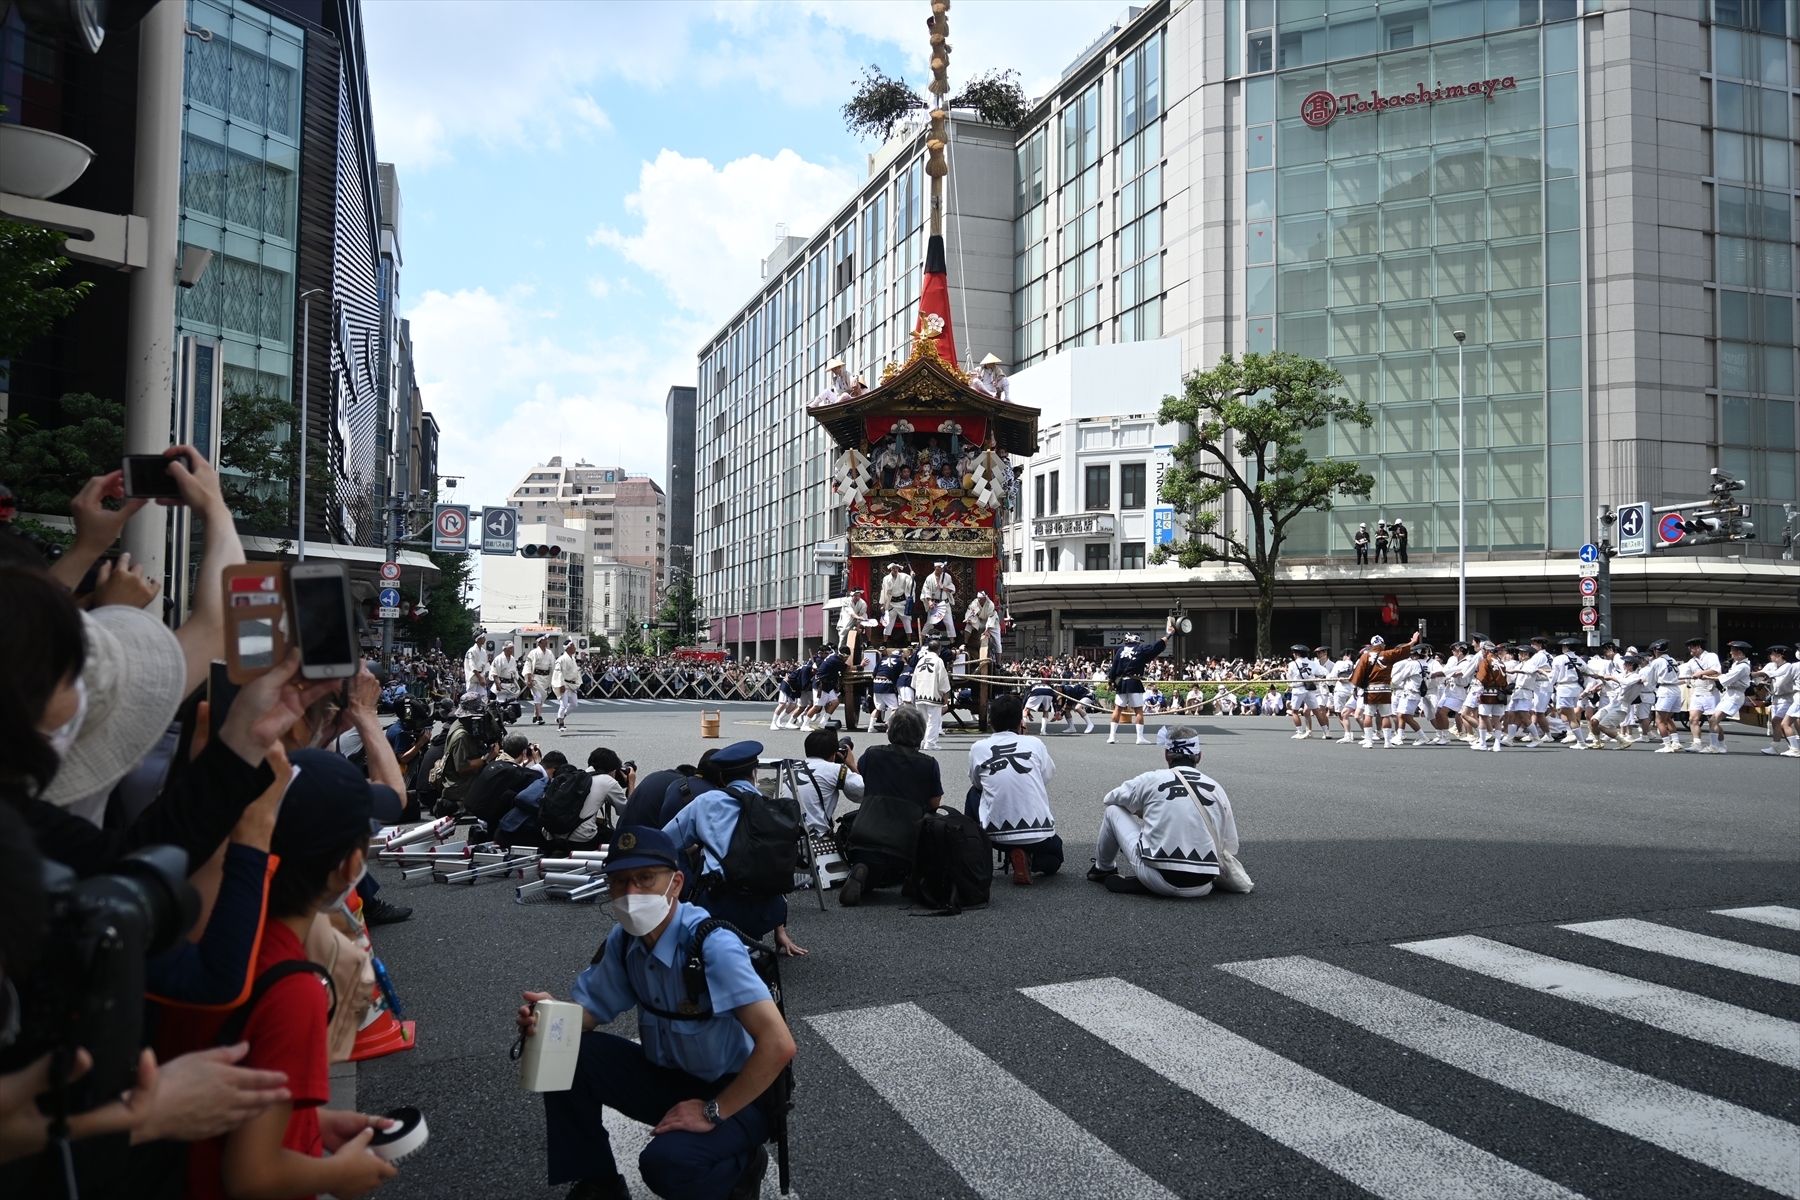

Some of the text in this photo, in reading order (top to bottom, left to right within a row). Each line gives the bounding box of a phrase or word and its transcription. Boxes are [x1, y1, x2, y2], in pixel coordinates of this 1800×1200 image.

[1339, 76, 1516, 115] Takashimaya
[1164, 512, 1171, 529] すぐ
[981, 742, 1032, 776] 長
